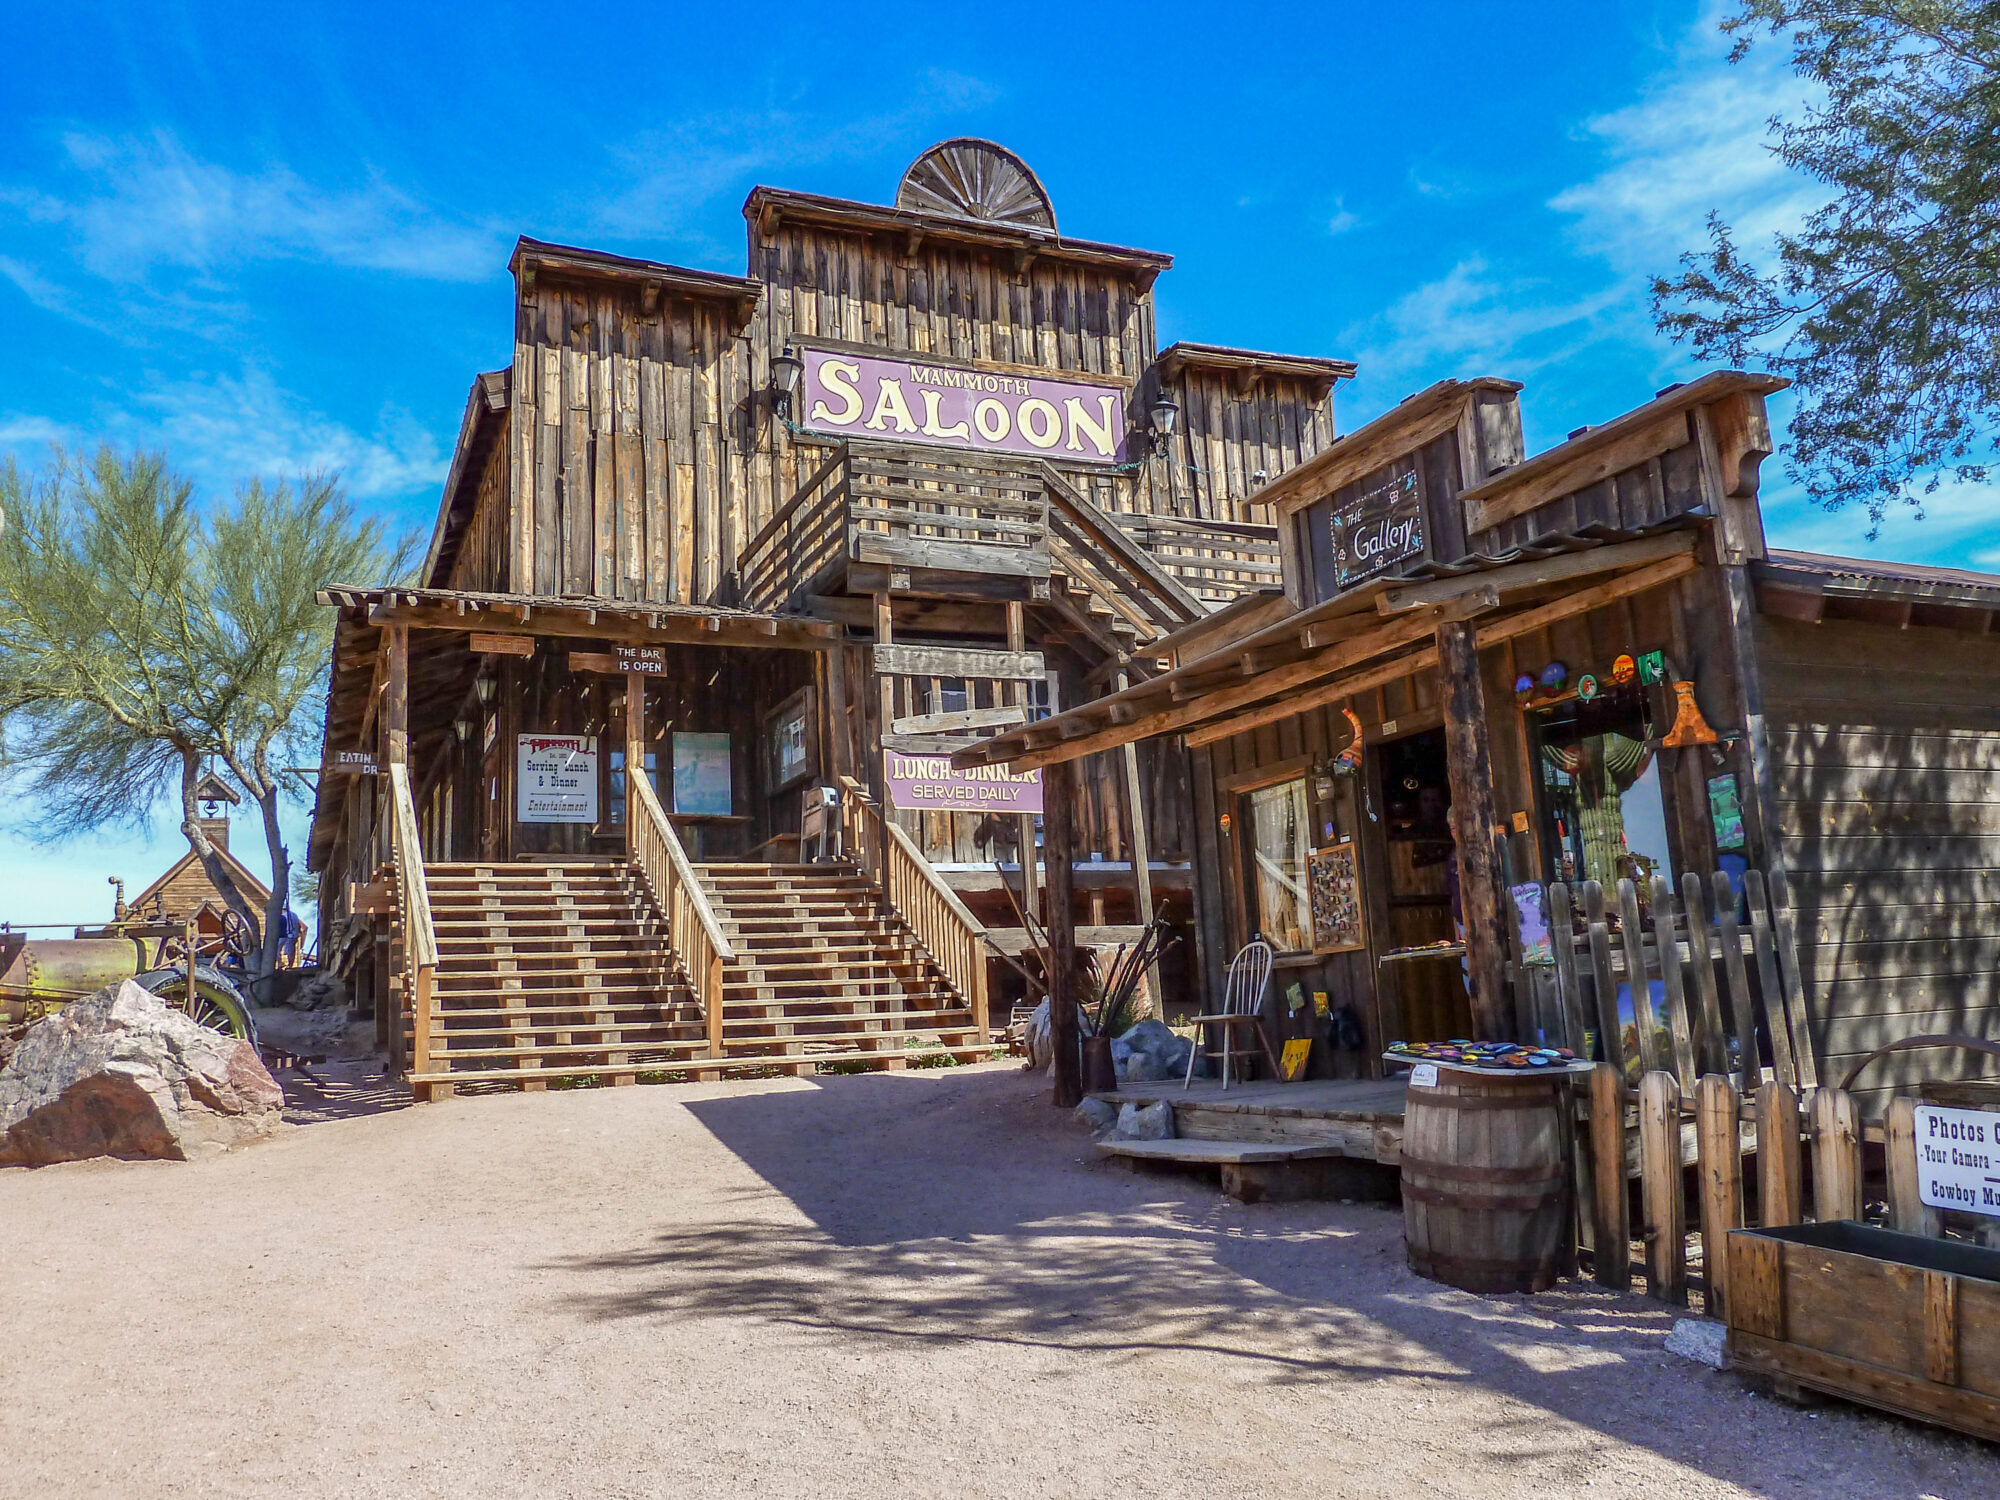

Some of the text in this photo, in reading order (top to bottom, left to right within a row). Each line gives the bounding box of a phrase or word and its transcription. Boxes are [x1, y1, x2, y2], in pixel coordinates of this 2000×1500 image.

[908, 364, 1031, 397] MAMMOTH
[811, 358, 1117, 457] SALOON
[1346, 507, 1363, 527] THE
[1354, 516, 1414, 560] Gallery
[617, 647, 660, 660] THE BAR
[619, 661, 662, 673] IS OPEN
[527, 760, 558, 775] Serving
[893, 758, 950, 780] LUNCH
[539, 776, 578, 787] & Dinner
[912, 785, 1020, 801] SERVED DAILY
[528, 800, 587, 812] Entertainment
[1929, 1115, 1984, 1142] Photos
[1952, 1148, 1990, 1169] Camera
[1932, 1180, 1976, 1207] Cowboy
